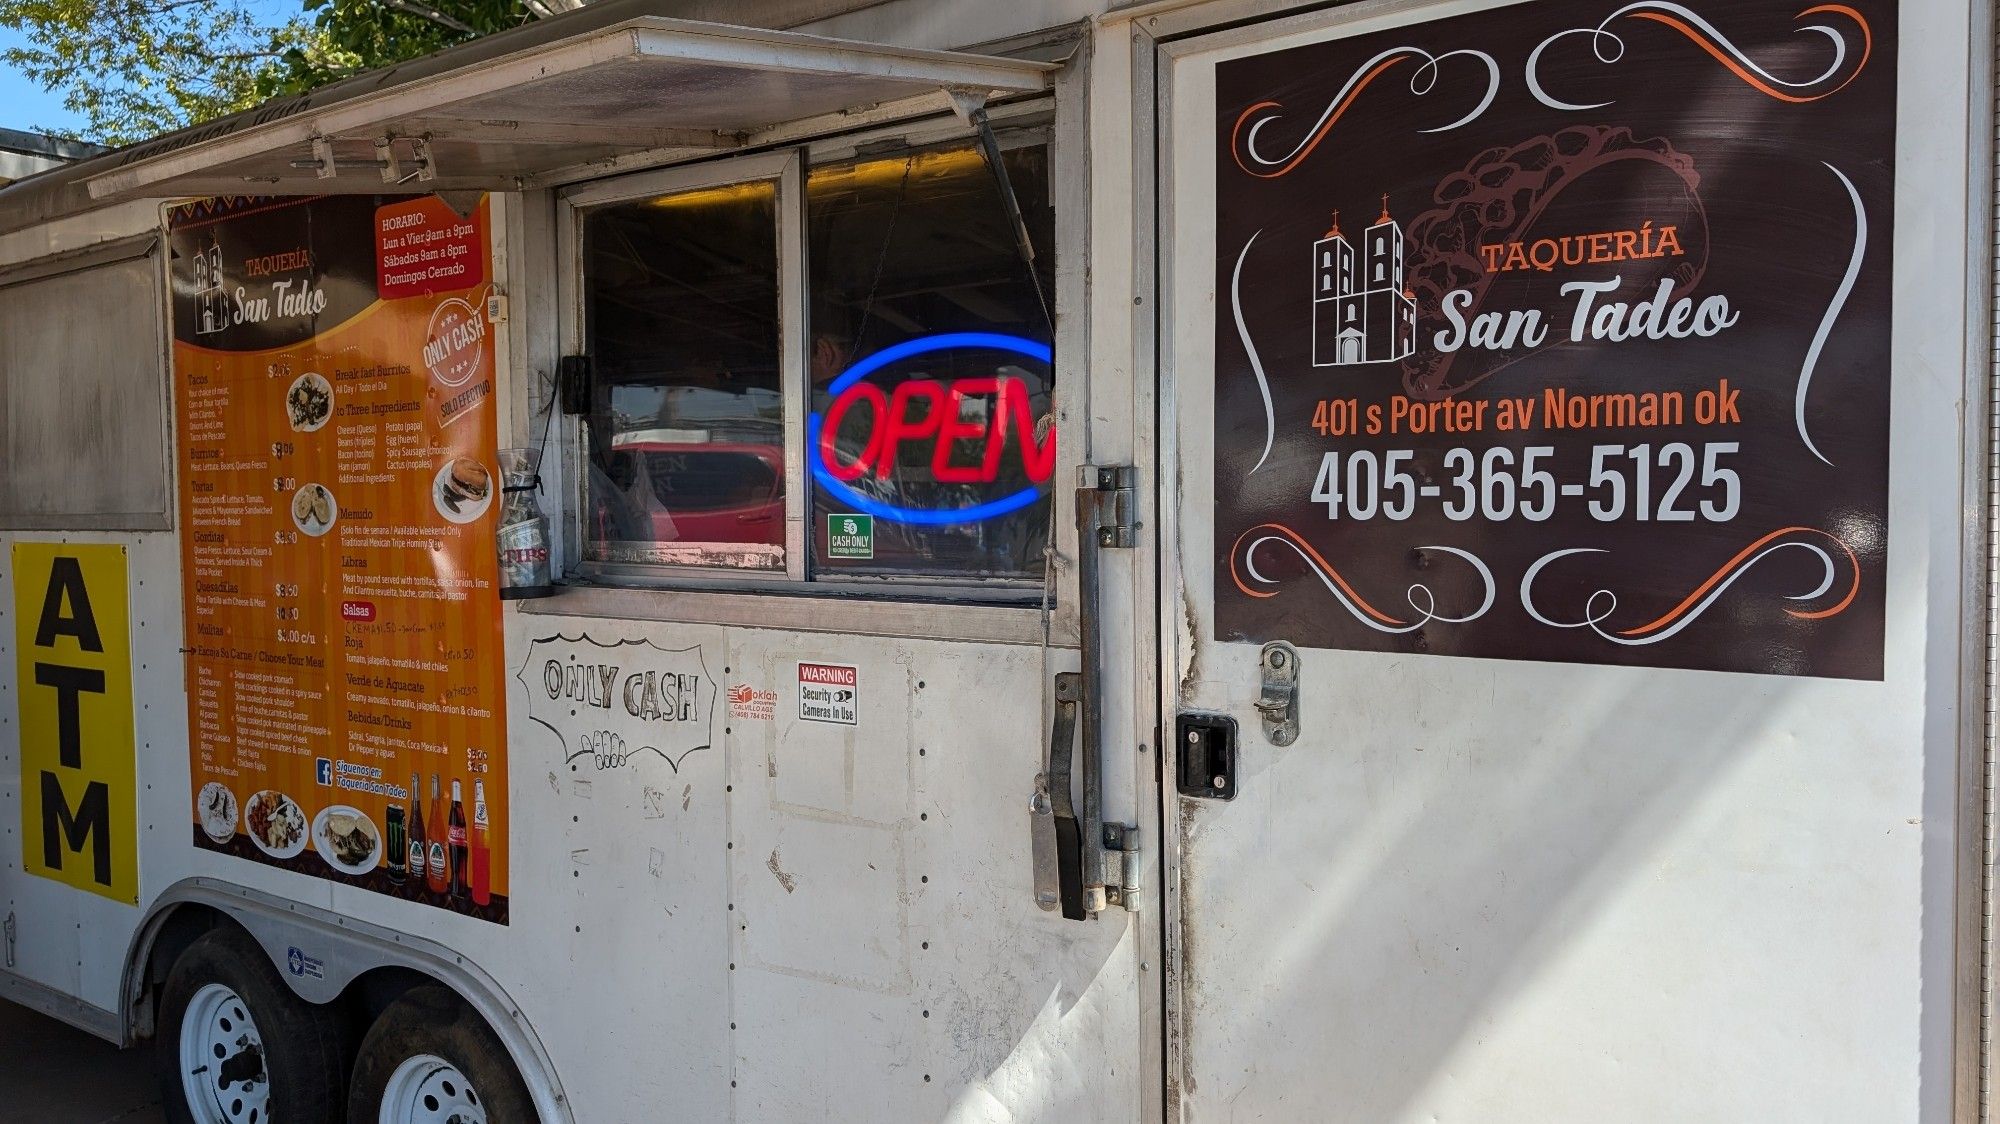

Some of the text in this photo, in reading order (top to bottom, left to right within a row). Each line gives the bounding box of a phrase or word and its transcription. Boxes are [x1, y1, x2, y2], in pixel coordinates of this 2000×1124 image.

[382, 213, 426, 232] HORARIO:
[383, 223, 474, 250] Lun a Vier 9am a 9pm
[1480, 219, 1684, 274] TAQUERÍA
[245, 249, 310, 277] TAQUERÍA
[382, 244, 468, 269] Sábados 9am a 8pm
[384, 263, 465, 287] Domingos Cerrado
[234, 277, 327, 326] San Tadeo
[1434, 276, 1740, 354] San Tadeo
[423, 313, 486, 369] ONLY CASH
[335, 369, 358, 381] Break
[376, 364, 411, 378] Burritos
[343, 385, 354, 395] Day
[359, 383, 371, 392] Todo
[440, 379, 491, 417] SOLO EFECTIVO
[336, 400, 421, 418] to Three Ingredients
[1311, 378, 1741, 436] 401 s Porter av Norman ok
[336, 424, 377, 436] Cheese (Queso)
[385, 422, 423, 434] Potato (papa)
[820, 376, 1057, 483] OPEN
[337, 438, 354, 448] Beans
[385, 434, 419, 446] Egg (huevo)
[337, 450, 354, 460] Bacon
[386, 448, 401, 459] Spicy
[402, 447, 427, 459] Sausage
[338, 463, 350, 471] Ham
[386, 460, 433, 472] Cactus (nopales)
[1310, 441, 1741, 522] 405-365-5125
[340, 507, 373, 520] Menudo
[363, 526, 370, 535] de
[394, 526, 419, 536] Available
[419, 526, 446, 536] weekend
[446, 526, 462, 538] Only
[341, 537, 369, 547] Traditional
[369, 538, 391, 548] Mexican
[392, 538, 406, 550] Tripe
[406, 538, 428, 550] Hominy
[832, 535, 869, 548] CASH ONLY
[341, 556, 367, 568] Libras
[504, 548, 547, 566] TIPS
[196, 579, 239, 594] Quesadillas
[342, 573, 356, 584] Meat
[356, 574, 364, 585] by
[364, 575, 380, 586] pound
[381, 575, 399, 585] served
[399, 576, 413, 586] with
[413, 577, 437, 588] tortillas,
[475, 578, 489, 589] lime
[342, 585, 354, 596] And
[354, 585, 375, 597] Cilantro
[447, 591, 468, 603] pastor
[343, 603, 370, 619] Salsas
[300, 631, 316, 645] c/u
[345, 635, 364, 650] Roja
[231, 648, 252, 661] Carne
[258, 651, 286, 664] Choose
[286, 653, 304, 666] Your
[305, 656, 324, 668] Meat
[346, 653, 367, 664] Tomato,
[391, 658, 416, 669] tomatillo
[415, 661, 421, 669] &
[421, 660, 431, 671] red
[431, 662, 449, 673] chiles
[346, 673, 425, 694] Verde de Aguacate
[801, 666, 855, 684] WARNING
[543, 658, 699, 722] ONLY CASH
[802, 685, 832, 704] Security
[346, 692, 367, 704] Creamy
[367, 695, 391, 706] avocado,
[391, 697, 416, 709] tomatillo,
[442, 703, 460, 714] onion
[460, 706, 466, 715] &
[467, 706, 491, 718] cilantro
[733, 704, 760, 712] CALVILLO
[802, 703, 854, 721] Cameras In Use
[34, 556, 112, 888] ATM
[347, 710, 412, 730] Bebidas/Drinks
[369, 782, 384, 796] San
[384, 783, 408, 799] Tadeo
